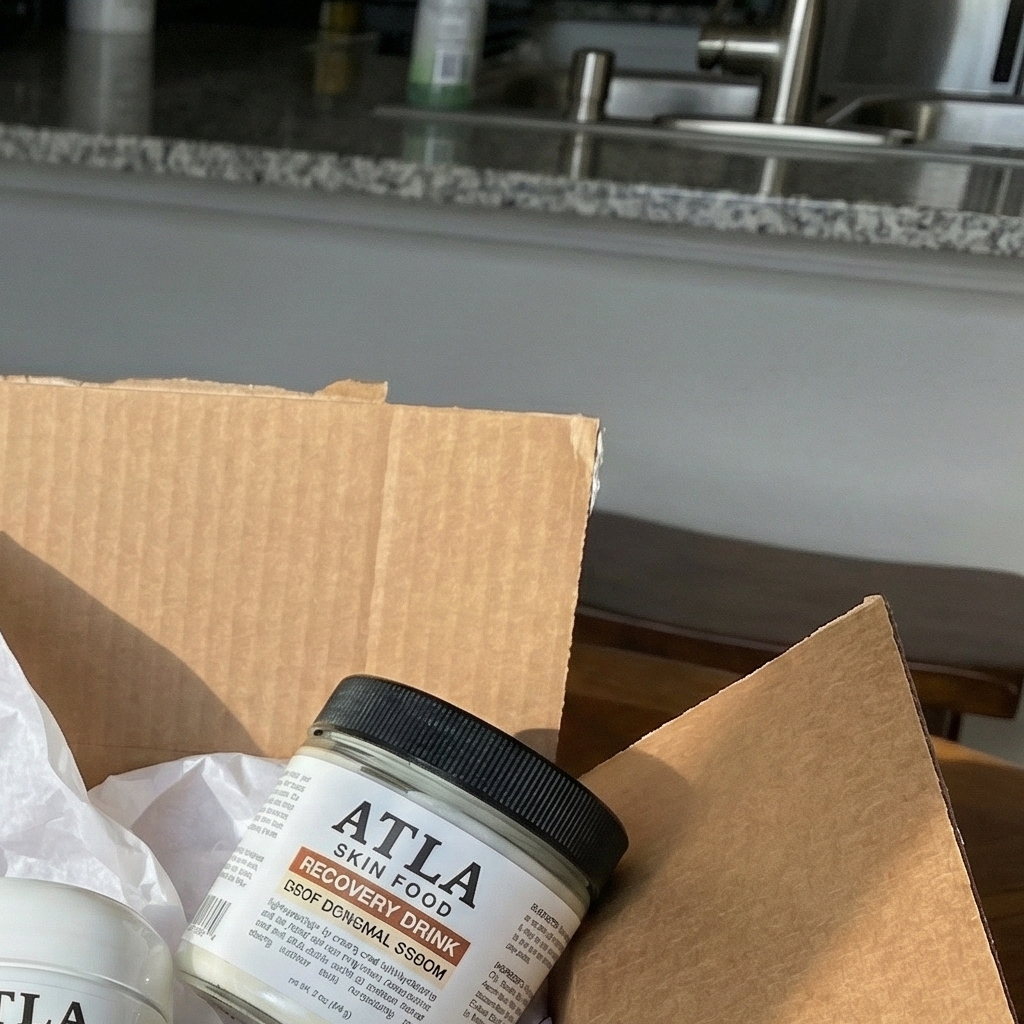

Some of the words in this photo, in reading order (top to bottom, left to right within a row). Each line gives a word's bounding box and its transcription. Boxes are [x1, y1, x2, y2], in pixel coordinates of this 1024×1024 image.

[331, 800, 482, 909] ATLA
[333, 843, 387, 880] SKIN
[391, 874, 452, 918] FOOD
[299, 855, 401, 918] RECOVERY
[399, 911, 461, 958] DRINK
